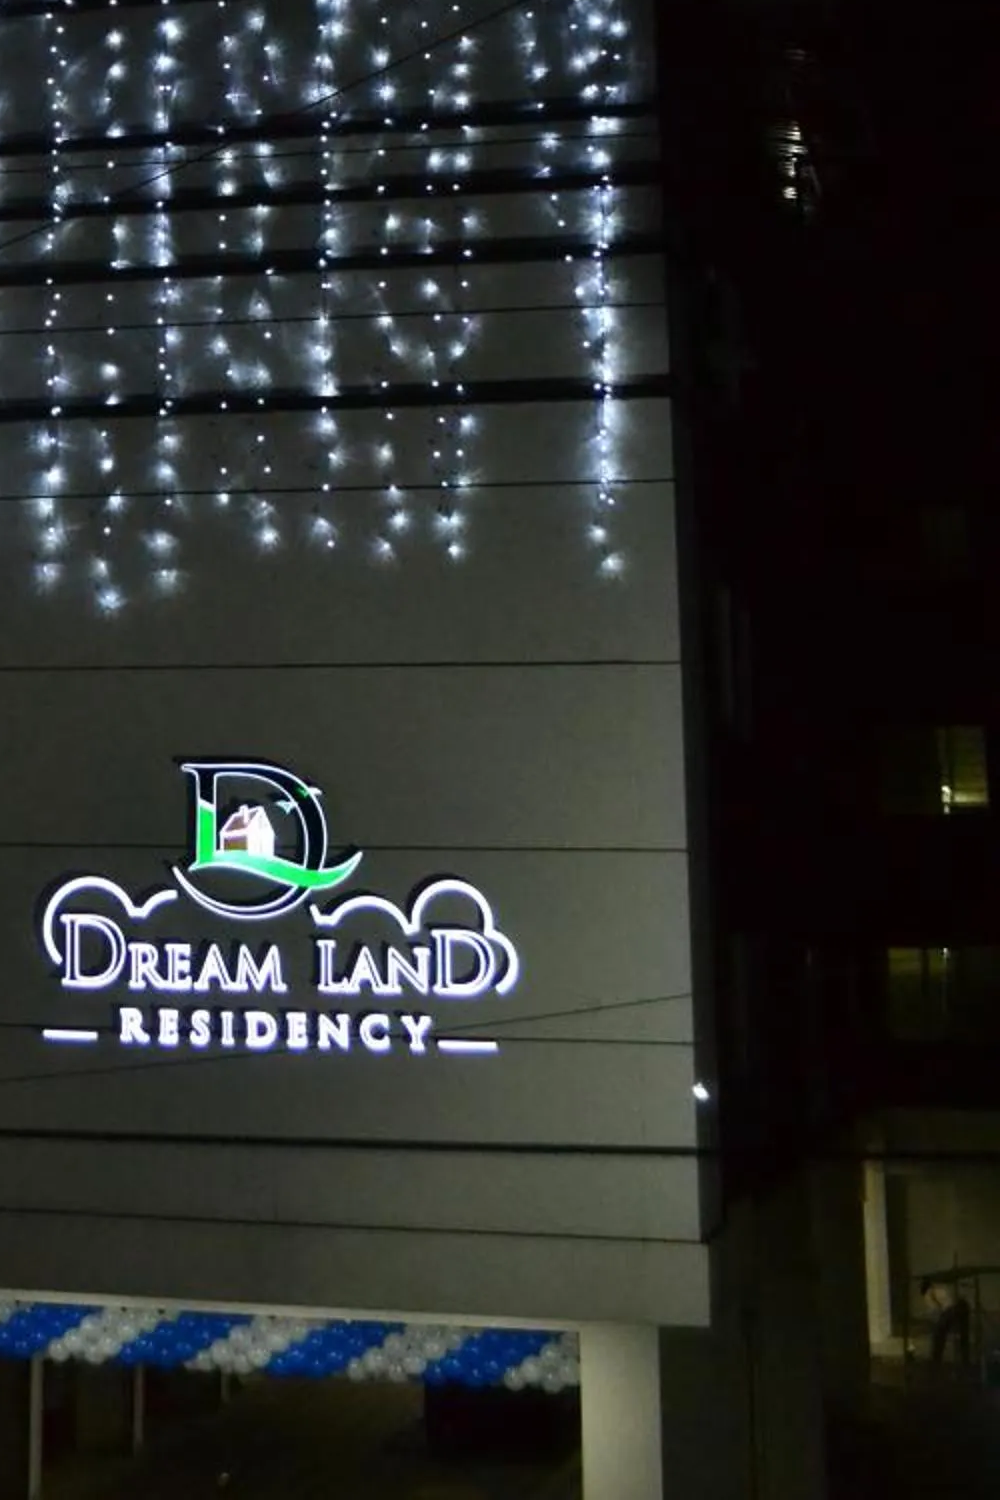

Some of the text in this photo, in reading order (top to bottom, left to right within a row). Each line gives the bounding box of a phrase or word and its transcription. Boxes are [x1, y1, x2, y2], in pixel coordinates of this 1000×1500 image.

[60, 912, 497, 997] DREAM LAND
[118, 1007, 433, 1053] RESIDENCY
